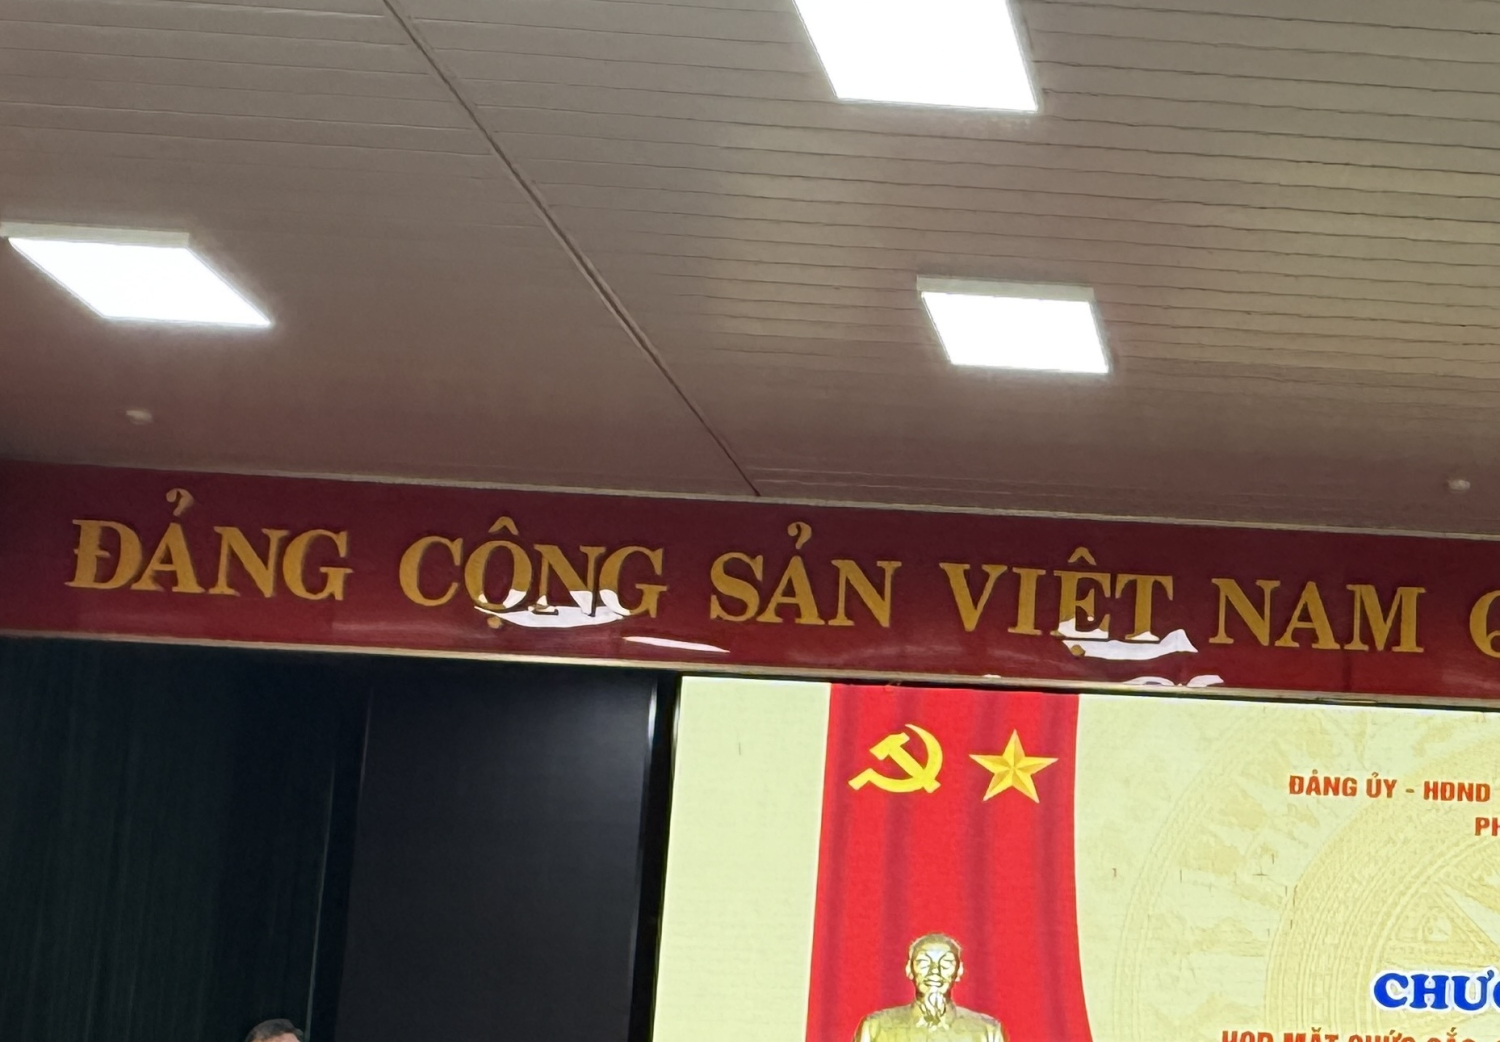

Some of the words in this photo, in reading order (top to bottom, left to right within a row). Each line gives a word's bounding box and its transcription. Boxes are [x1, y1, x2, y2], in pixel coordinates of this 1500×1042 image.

[65, 487, 349, 600] ĐẢNG
[399, 516, 668, 629] CỘNG
[709, 521, 895, 628] SẢN
[939, 547, 1175, 656] VIỆT
[1210, 577, 1425, 653] NAM
[1289, 769, 1357, 797] ĐẢNG
[1366, 772, 1397, 798] ỦY
[1423, 780, 1491, 802] HĐND
